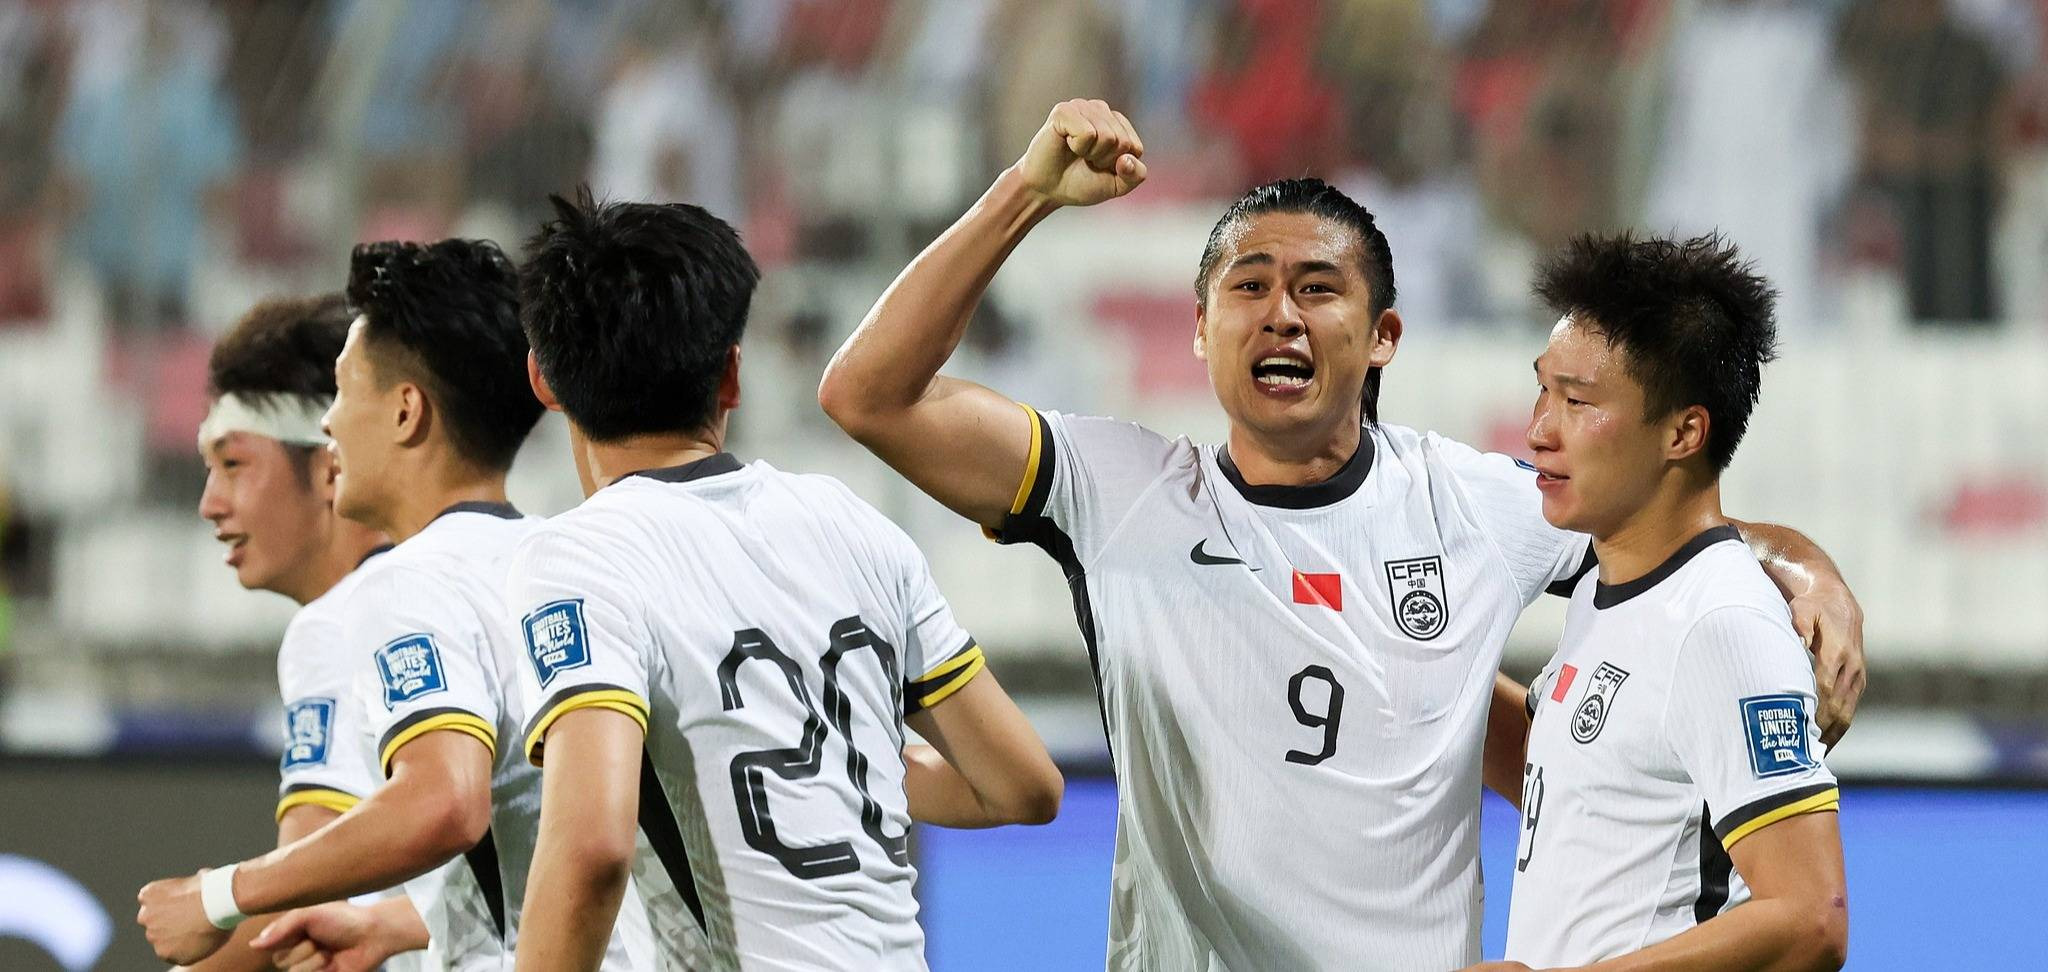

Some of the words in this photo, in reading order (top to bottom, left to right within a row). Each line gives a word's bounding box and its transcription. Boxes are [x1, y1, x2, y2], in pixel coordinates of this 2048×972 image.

[1392, 562, 1437, 580] CFA
[1408, 578, 1426, 589] 中国
[1594, 667, 1622, 688] CFA
[1285, 664, 1345, 766] 9
[1758, 708, 1797, 721] FOOTBALL
[1760, 720, 1798, 736] UNITES
[717, 615, 911, 880] 20
[1760, 736, 1777, 750] the
[1777, 735, 1800, 749] World
